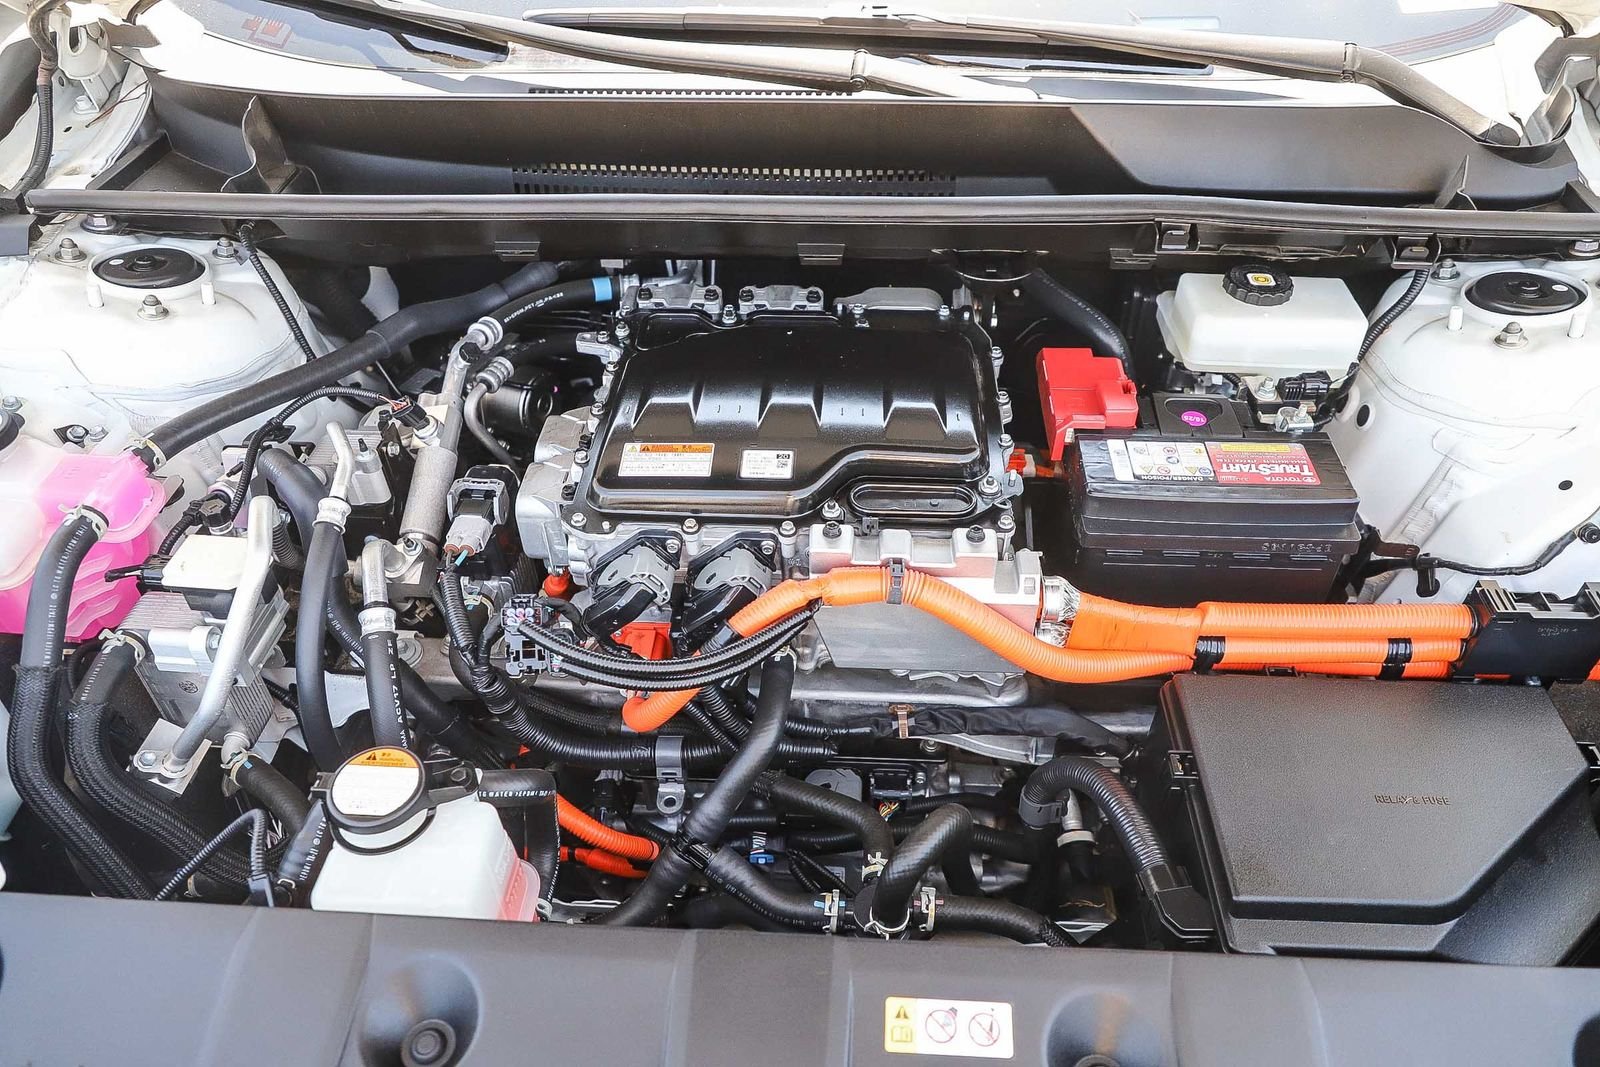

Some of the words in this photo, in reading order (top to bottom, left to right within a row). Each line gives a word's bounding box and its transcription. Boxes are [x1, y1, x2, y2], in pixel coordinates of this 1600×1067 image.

[389, 663, 397, 679] LP
[392, 685, 404, 723] ACV17
[1375, 794, 1408, 804] RELAY
[1422, 796, 1451, 806] FUSE
